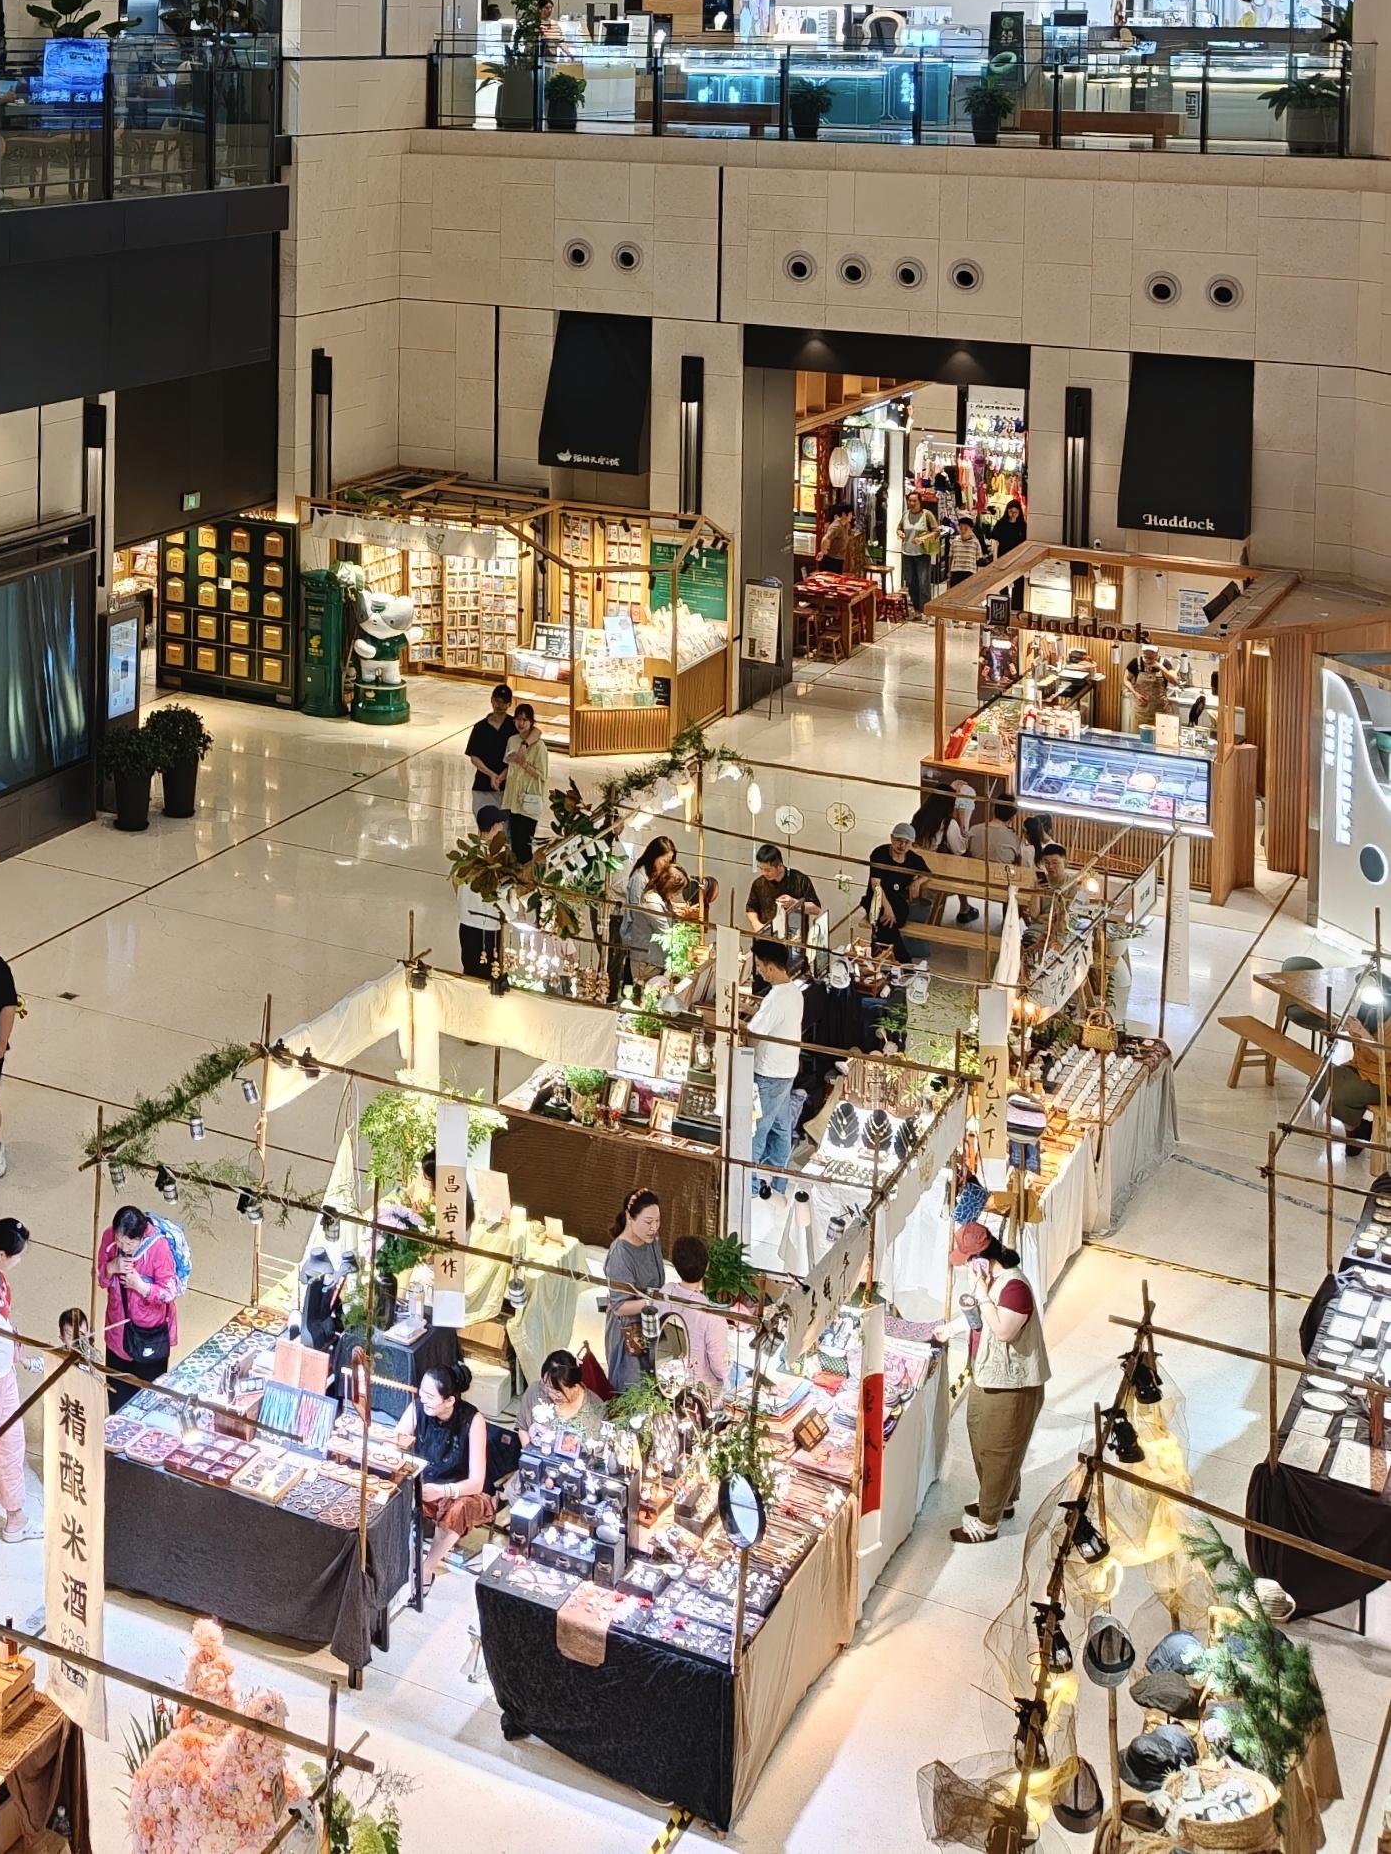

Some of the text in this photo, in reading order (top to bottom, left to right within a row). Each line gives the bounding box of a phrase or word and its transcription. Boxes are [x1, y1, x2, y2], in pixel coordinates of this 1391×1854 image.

[1142, 513, 1215, 531] Haddock
[1016, 611, 1152, 645] Haddock
[59, 1392, 87, 1628] 精酿米酒
[60, 1621, 90, 1653] GOOD
